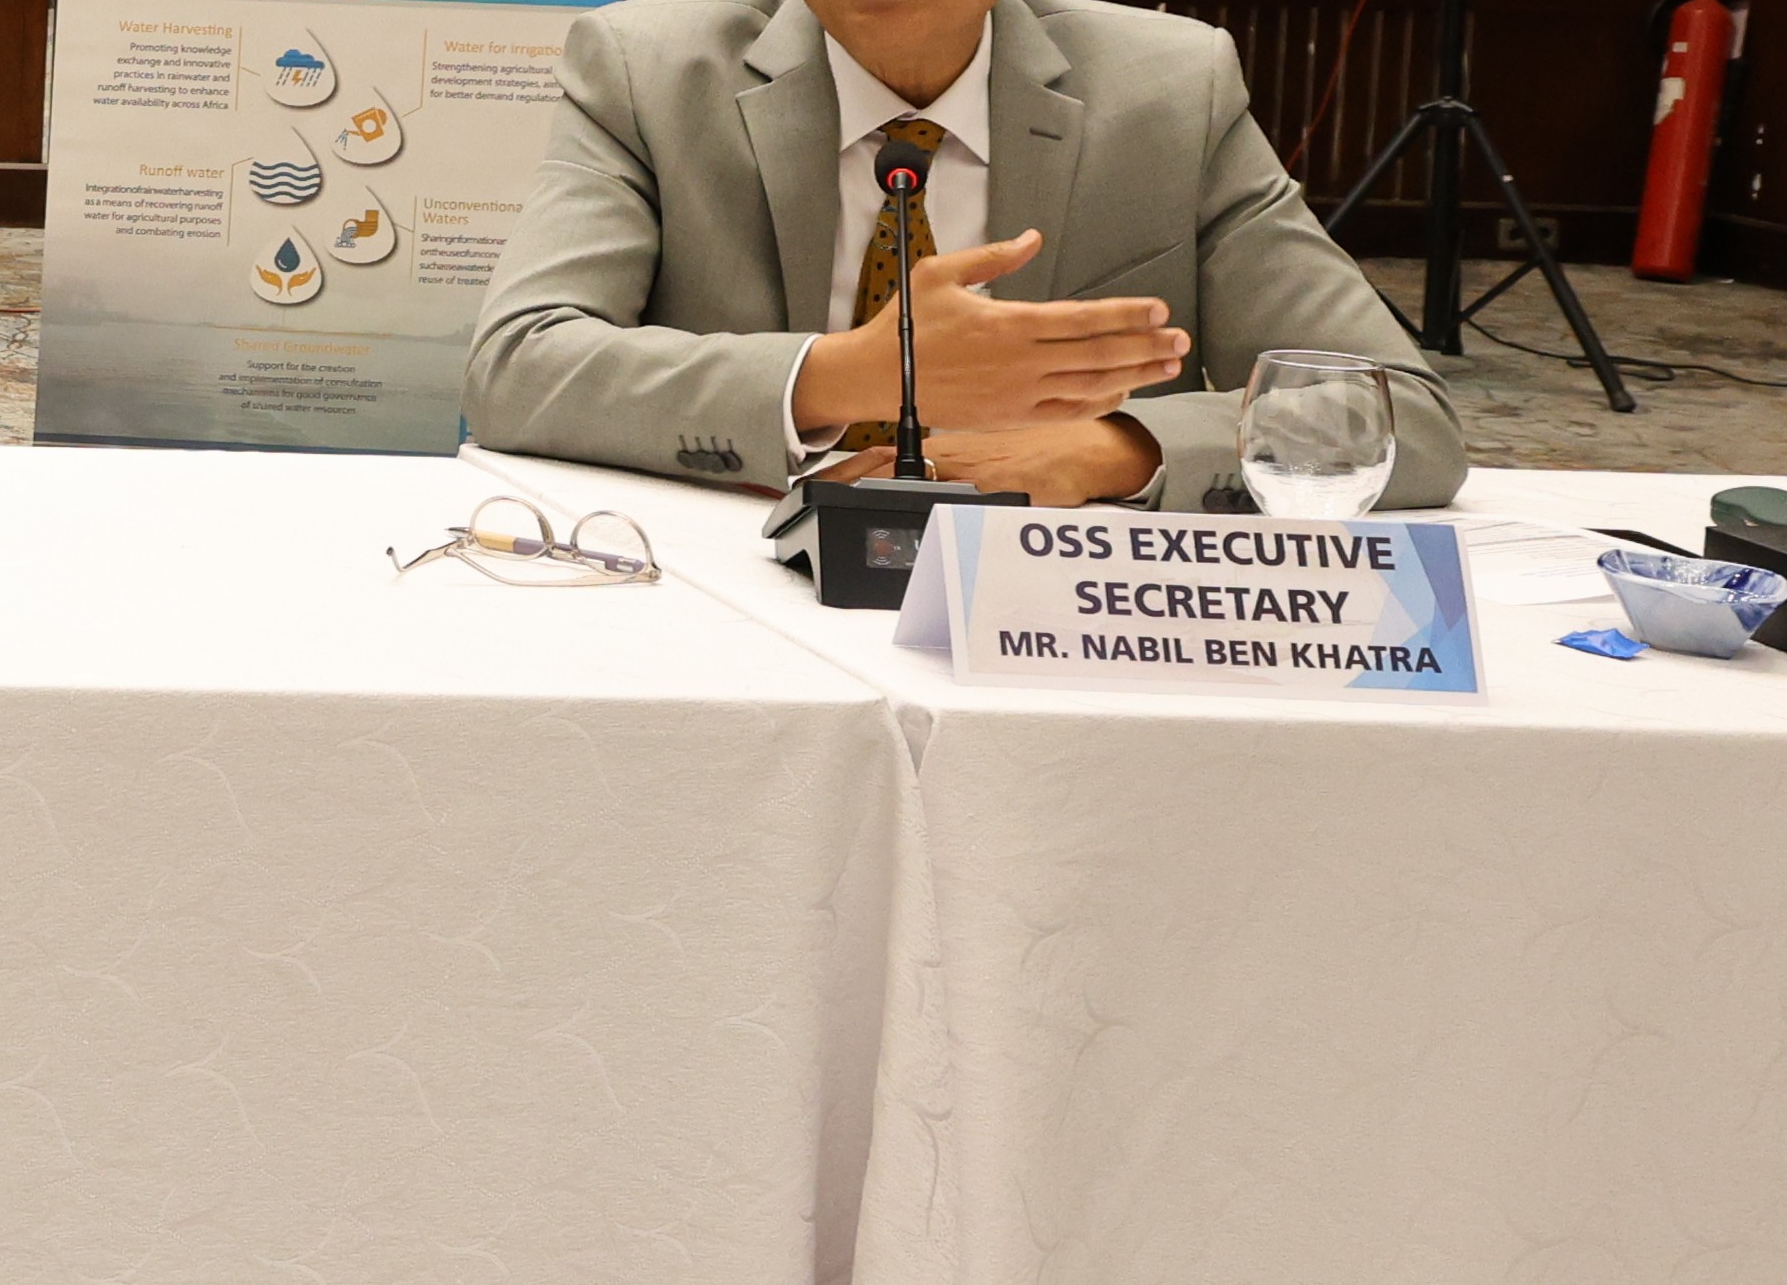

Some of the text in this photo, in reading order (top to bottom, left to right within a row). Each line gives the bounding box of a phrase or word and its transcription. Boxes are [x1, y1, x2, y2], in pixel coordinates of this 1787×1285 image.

[511, 44, 563, 58] irrigatio
[423, 198, 524, 213] Unconventiona
[1019, 523, 1395, 569] OSS EXECUTIVE
[1075, 581, 1348, 622] SECRETARY
[999, 630, 1442, 672] MR. NABIL BEN KHATRA
